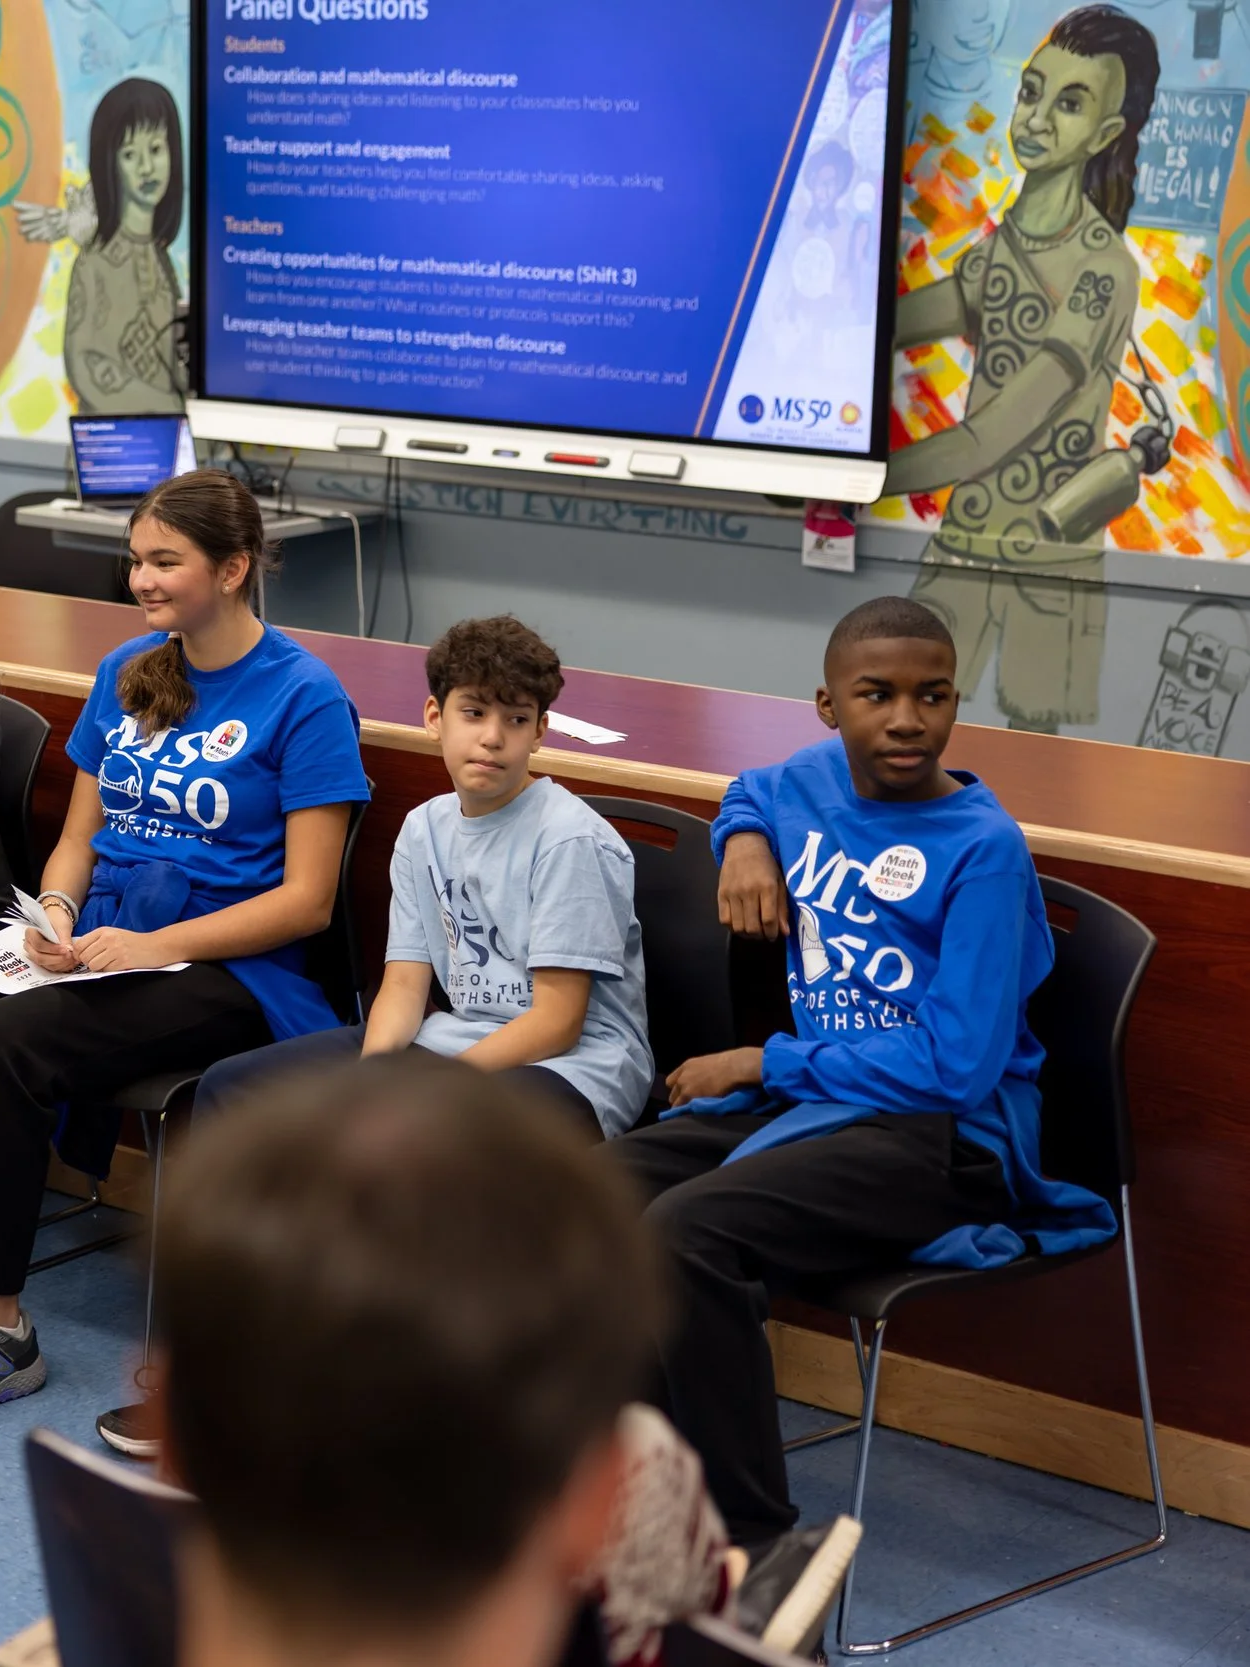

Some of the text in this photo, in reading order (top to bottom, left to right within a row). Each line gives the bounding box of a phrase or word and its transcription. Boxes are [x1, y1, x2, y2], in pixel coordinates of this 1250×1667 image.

[225, 0, 429, 25] Panel Questions
[224, 35, 285, 53] Students
[224, 66, 518, 88] Collaboration and mathematical discourse
[224, 135, 450, 161] Teacher support and engagement
[1165, 146, 1188, 168] ES
[223, 215, 284, 235] Teachers
[223, 245, 638, 288] Creating opportunities for mathematical discourse (Shift 3)
[223, 314, 567, 355] Leveraging teacher teams to strengthen discourse
[149, 768, 230, 830] 50
[886, 854, 919, 870] Math
[880, 865, 915, 882] Week
[826, 934, 914, 992] 50
[498, 980, 534, 995] THE
[834, 988, 861, 1007] OF
